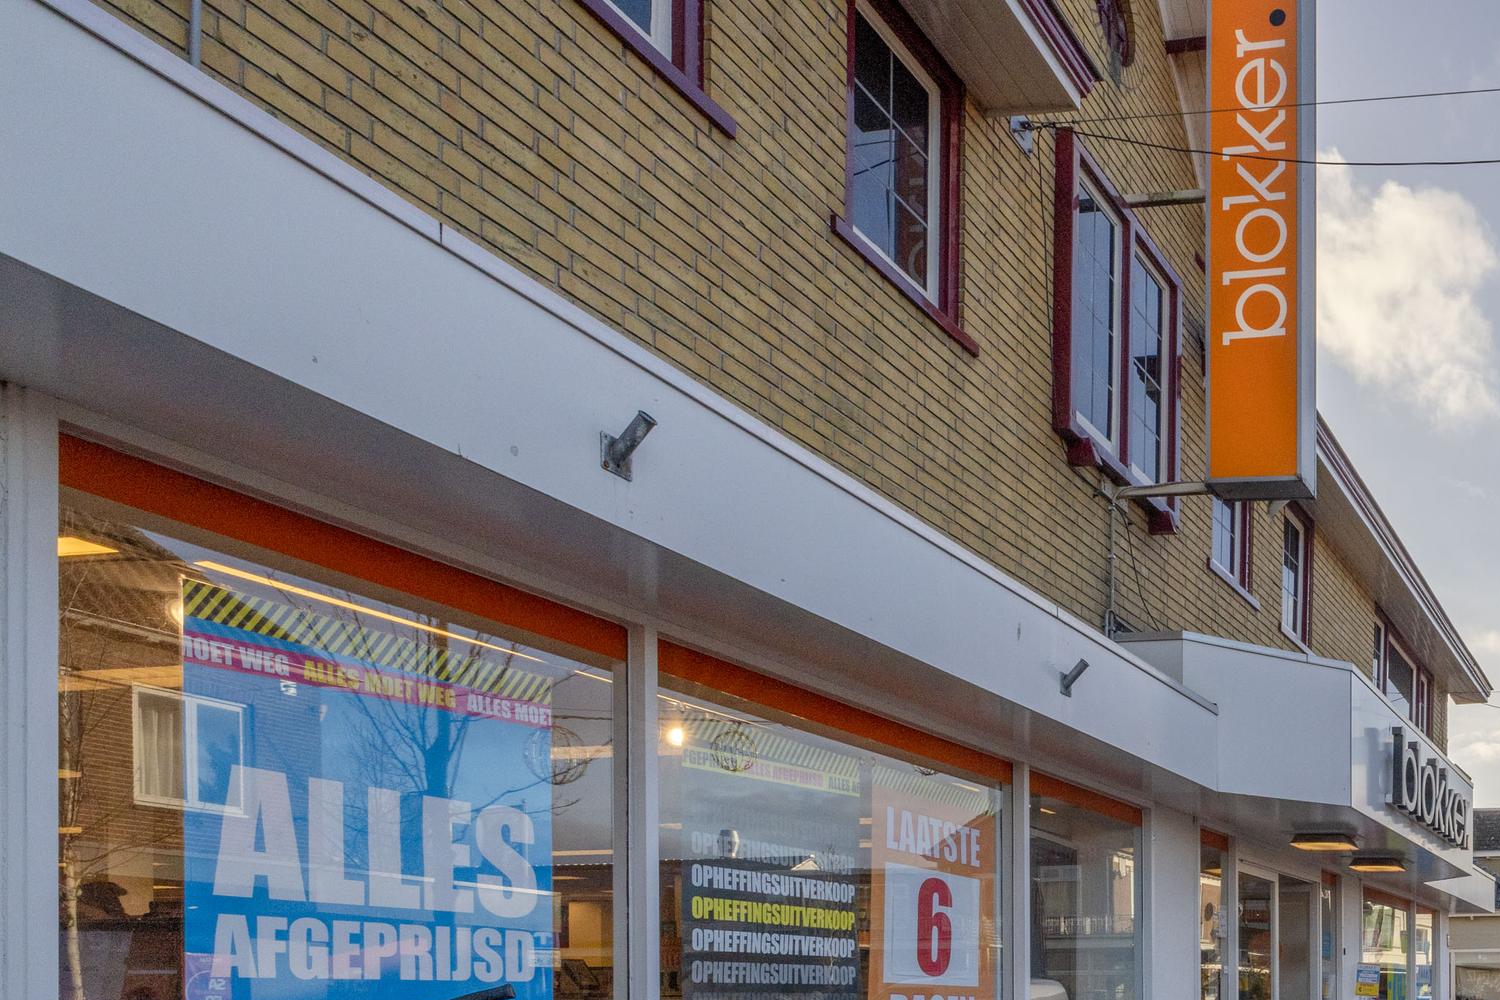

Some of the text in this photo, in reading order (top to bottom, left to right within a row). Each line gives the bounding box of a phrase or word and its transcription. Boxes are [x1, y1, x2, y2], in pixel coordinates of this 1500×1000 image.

[239, 647, 290, 677] WEG
[303, 660, 457, 708] ALLES MOET WEG
[467, 694, 513, 719] ALLES
[828, 776, 851, 792] ALLES
[212, 763, 538, 920] ALLES
[886, 806, 981, 868] LAATSTE
[691, 863, 856, 903] OPHEFFINGSUITVERKOOP
[691, 896, 856, 931] OPHEFFINGSUITVERKOOP
[917, 877, 953, 977] 6
[209, 913, 536, 984] AFGEPRIJSD
[691, 928, 856, 958] OPHEFFINGSUITVERKOOP
[691, 960, 857, 986] OPHEFFINGSUITVERKOOP
